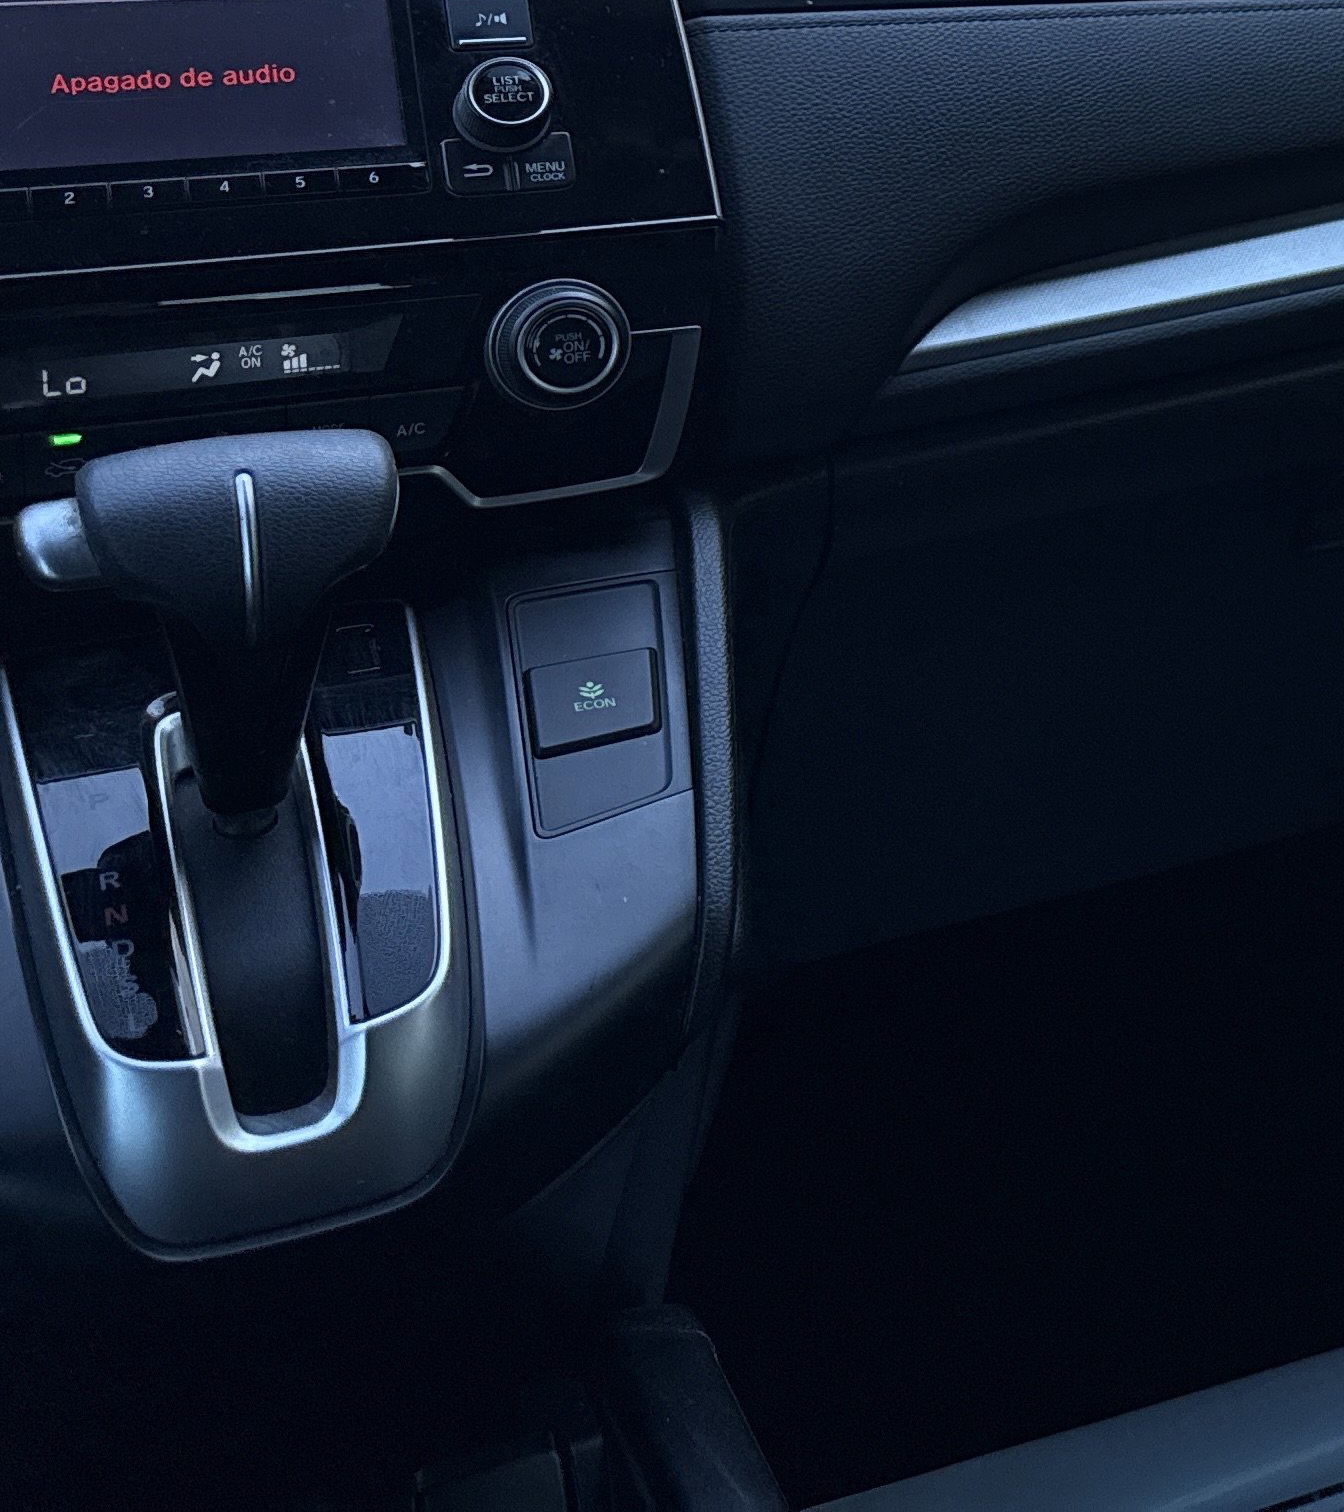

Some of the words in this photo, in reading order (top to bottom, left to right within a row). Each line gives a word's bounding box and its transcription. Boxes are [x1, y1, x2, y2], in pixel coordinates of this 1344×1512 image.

[51, 70, 171, 96] Apagado
[180, 67, 214, 89] de
[223, 64, 296, 86] audio
[492, 75, 520, 86] LIST
[483, 91, 535, 104] SELECT
[525, 160, 566, 174] MENU
[530, 172, 566, 182] CLOCK
[64, 191, 76, 206] 2
[143, 185, 155, 199] 3
[219, 179, 231, 193] 4
[295, 175, 306, 189] 5
[368, 170, 380, 184] 6
[555, 332, 583, 342] PUSH
[562, 339, 591, 353] ON/
[240, 356, 262, 370] ON
[563, 351, 592, 365] OFF
[42, 369, 87, 398] Lo
[238, 344, 263, 359] A/C
[396, 421, 427, 439] A/C
[573, 697, 617, 712] ECON
[89, 792, 109, 811] P
[99, 871, 121, 891] R
[104, 903, 129, 926] N
[112, 939, 135, 959] D
